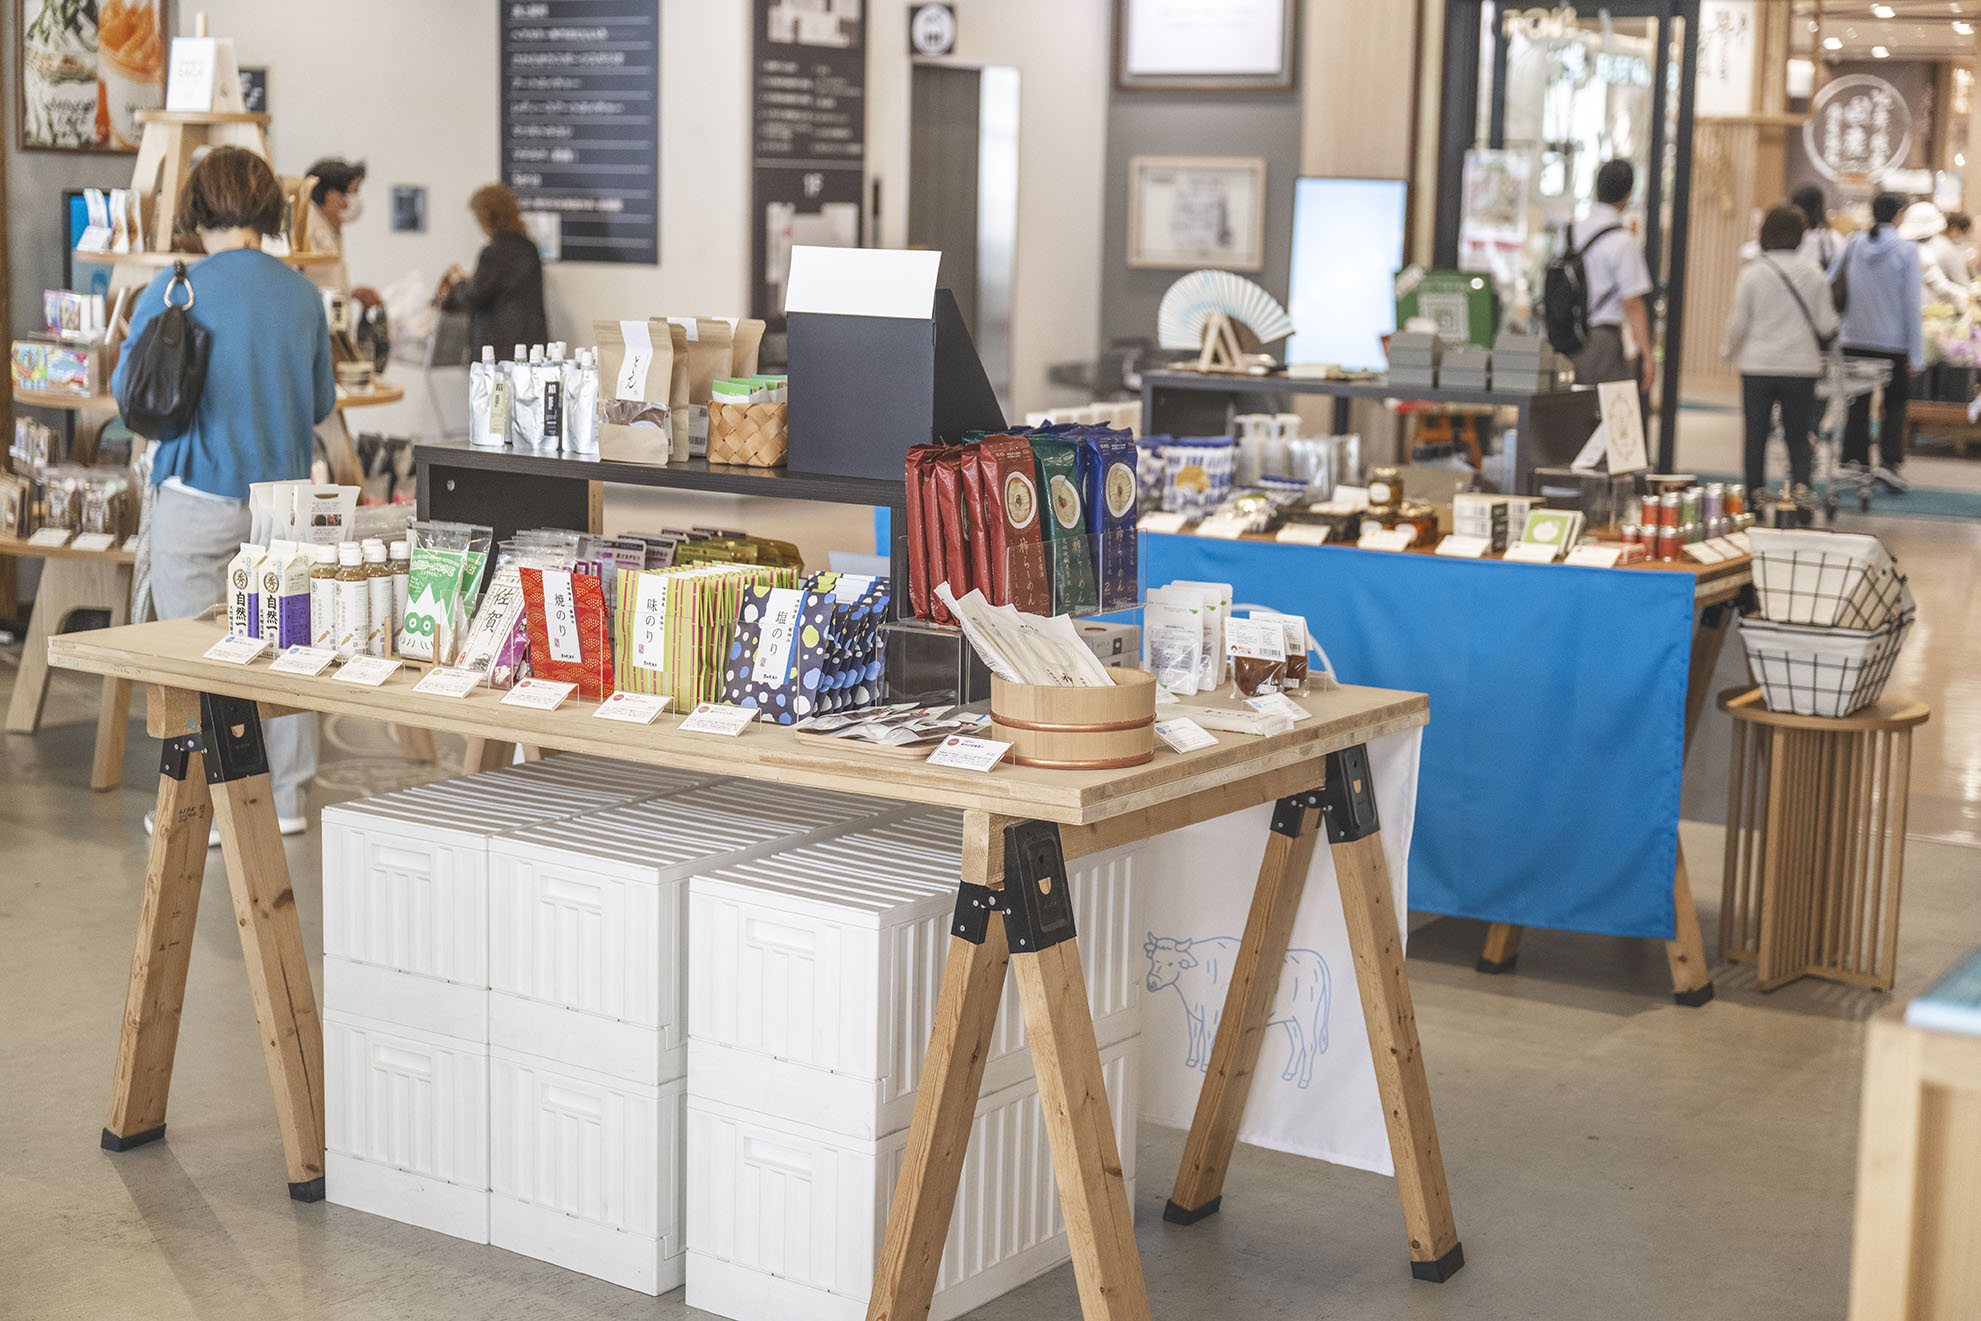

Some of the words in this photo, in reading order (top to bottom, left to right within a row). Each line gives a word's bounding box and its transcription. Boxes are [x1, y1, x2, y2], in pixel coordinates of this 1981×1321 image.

[1104, 581, 1111, 592] 2
[235, 591, 246, 627] 自然一
[266, 594, 278, 631] 自然一
[482, 587, 514, 633] 佐賀
[555, 593, 567, 637] 焼のり
[645, 598, 658, 643] 味のり
[770, 611, 788, 656] 塩のり
